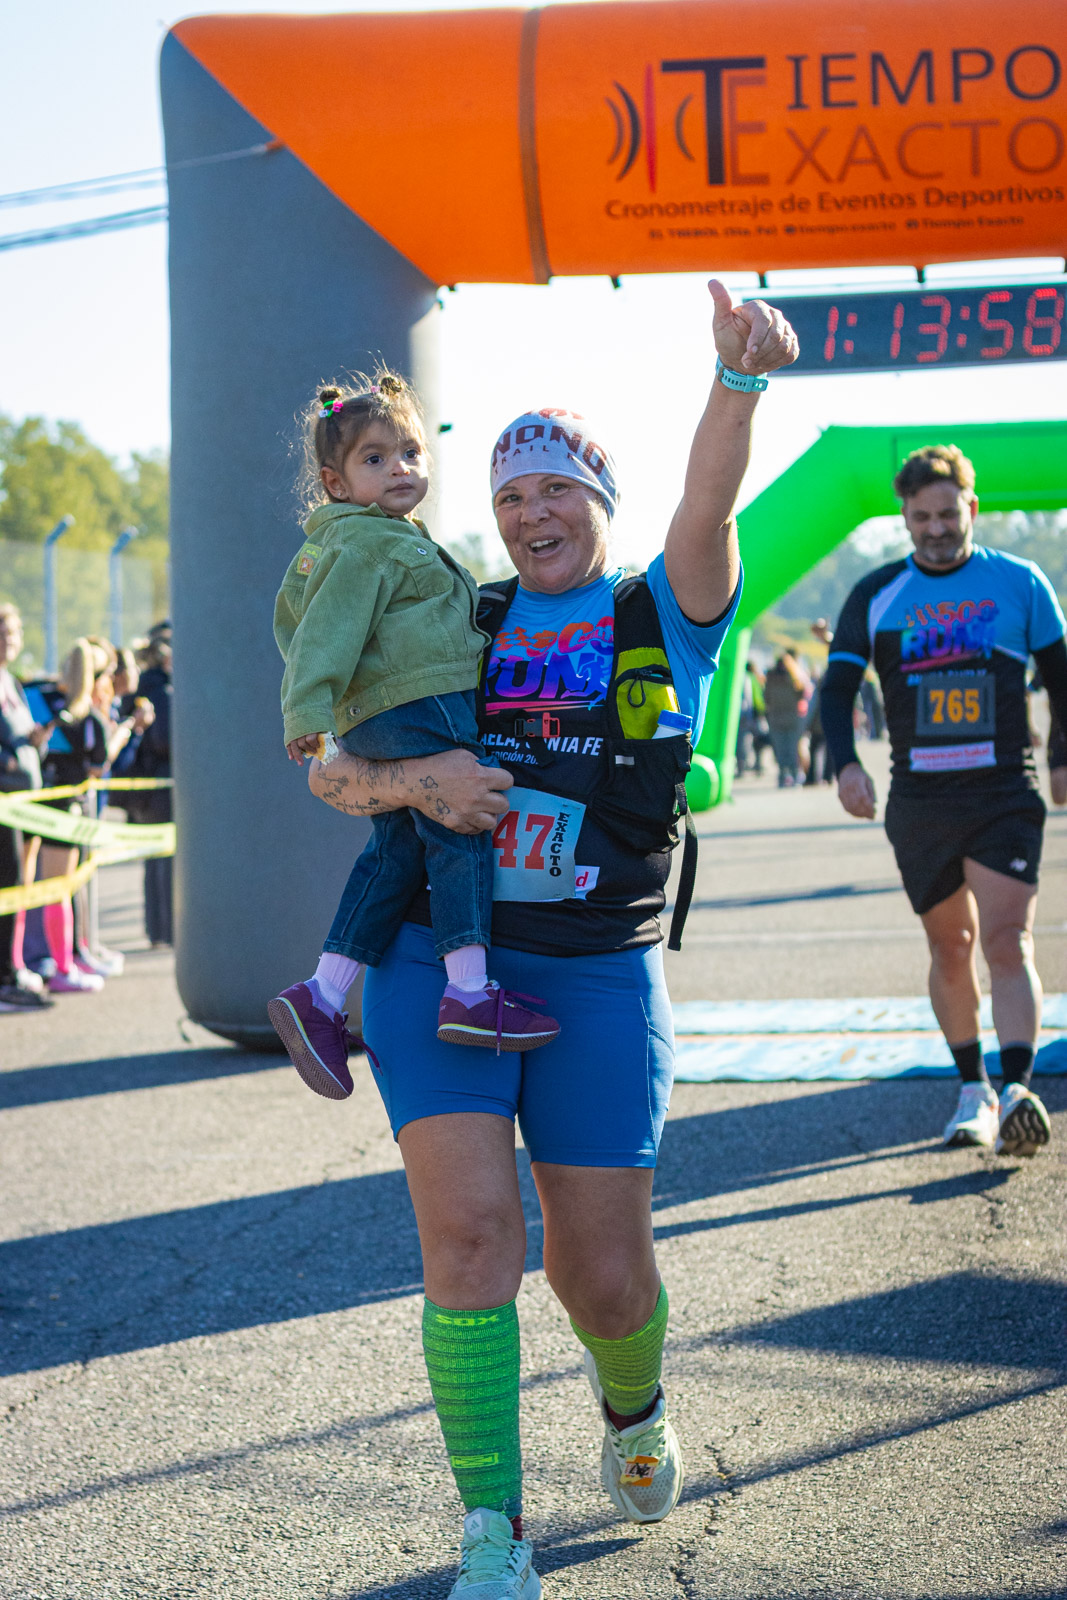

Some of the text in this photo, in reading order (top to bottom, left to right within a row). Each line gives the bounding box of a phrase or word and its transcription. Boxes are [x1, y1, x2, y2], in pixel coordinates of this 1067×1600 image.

[605, 183, 1065, 219] Cronometraje de Eventos Deportivos
[929, 688, 981, 723] 765
[581, 736, 604, 757] FE
[492, 810, 555, 870] 47
[549, 811, 571, 877] EXACTO
